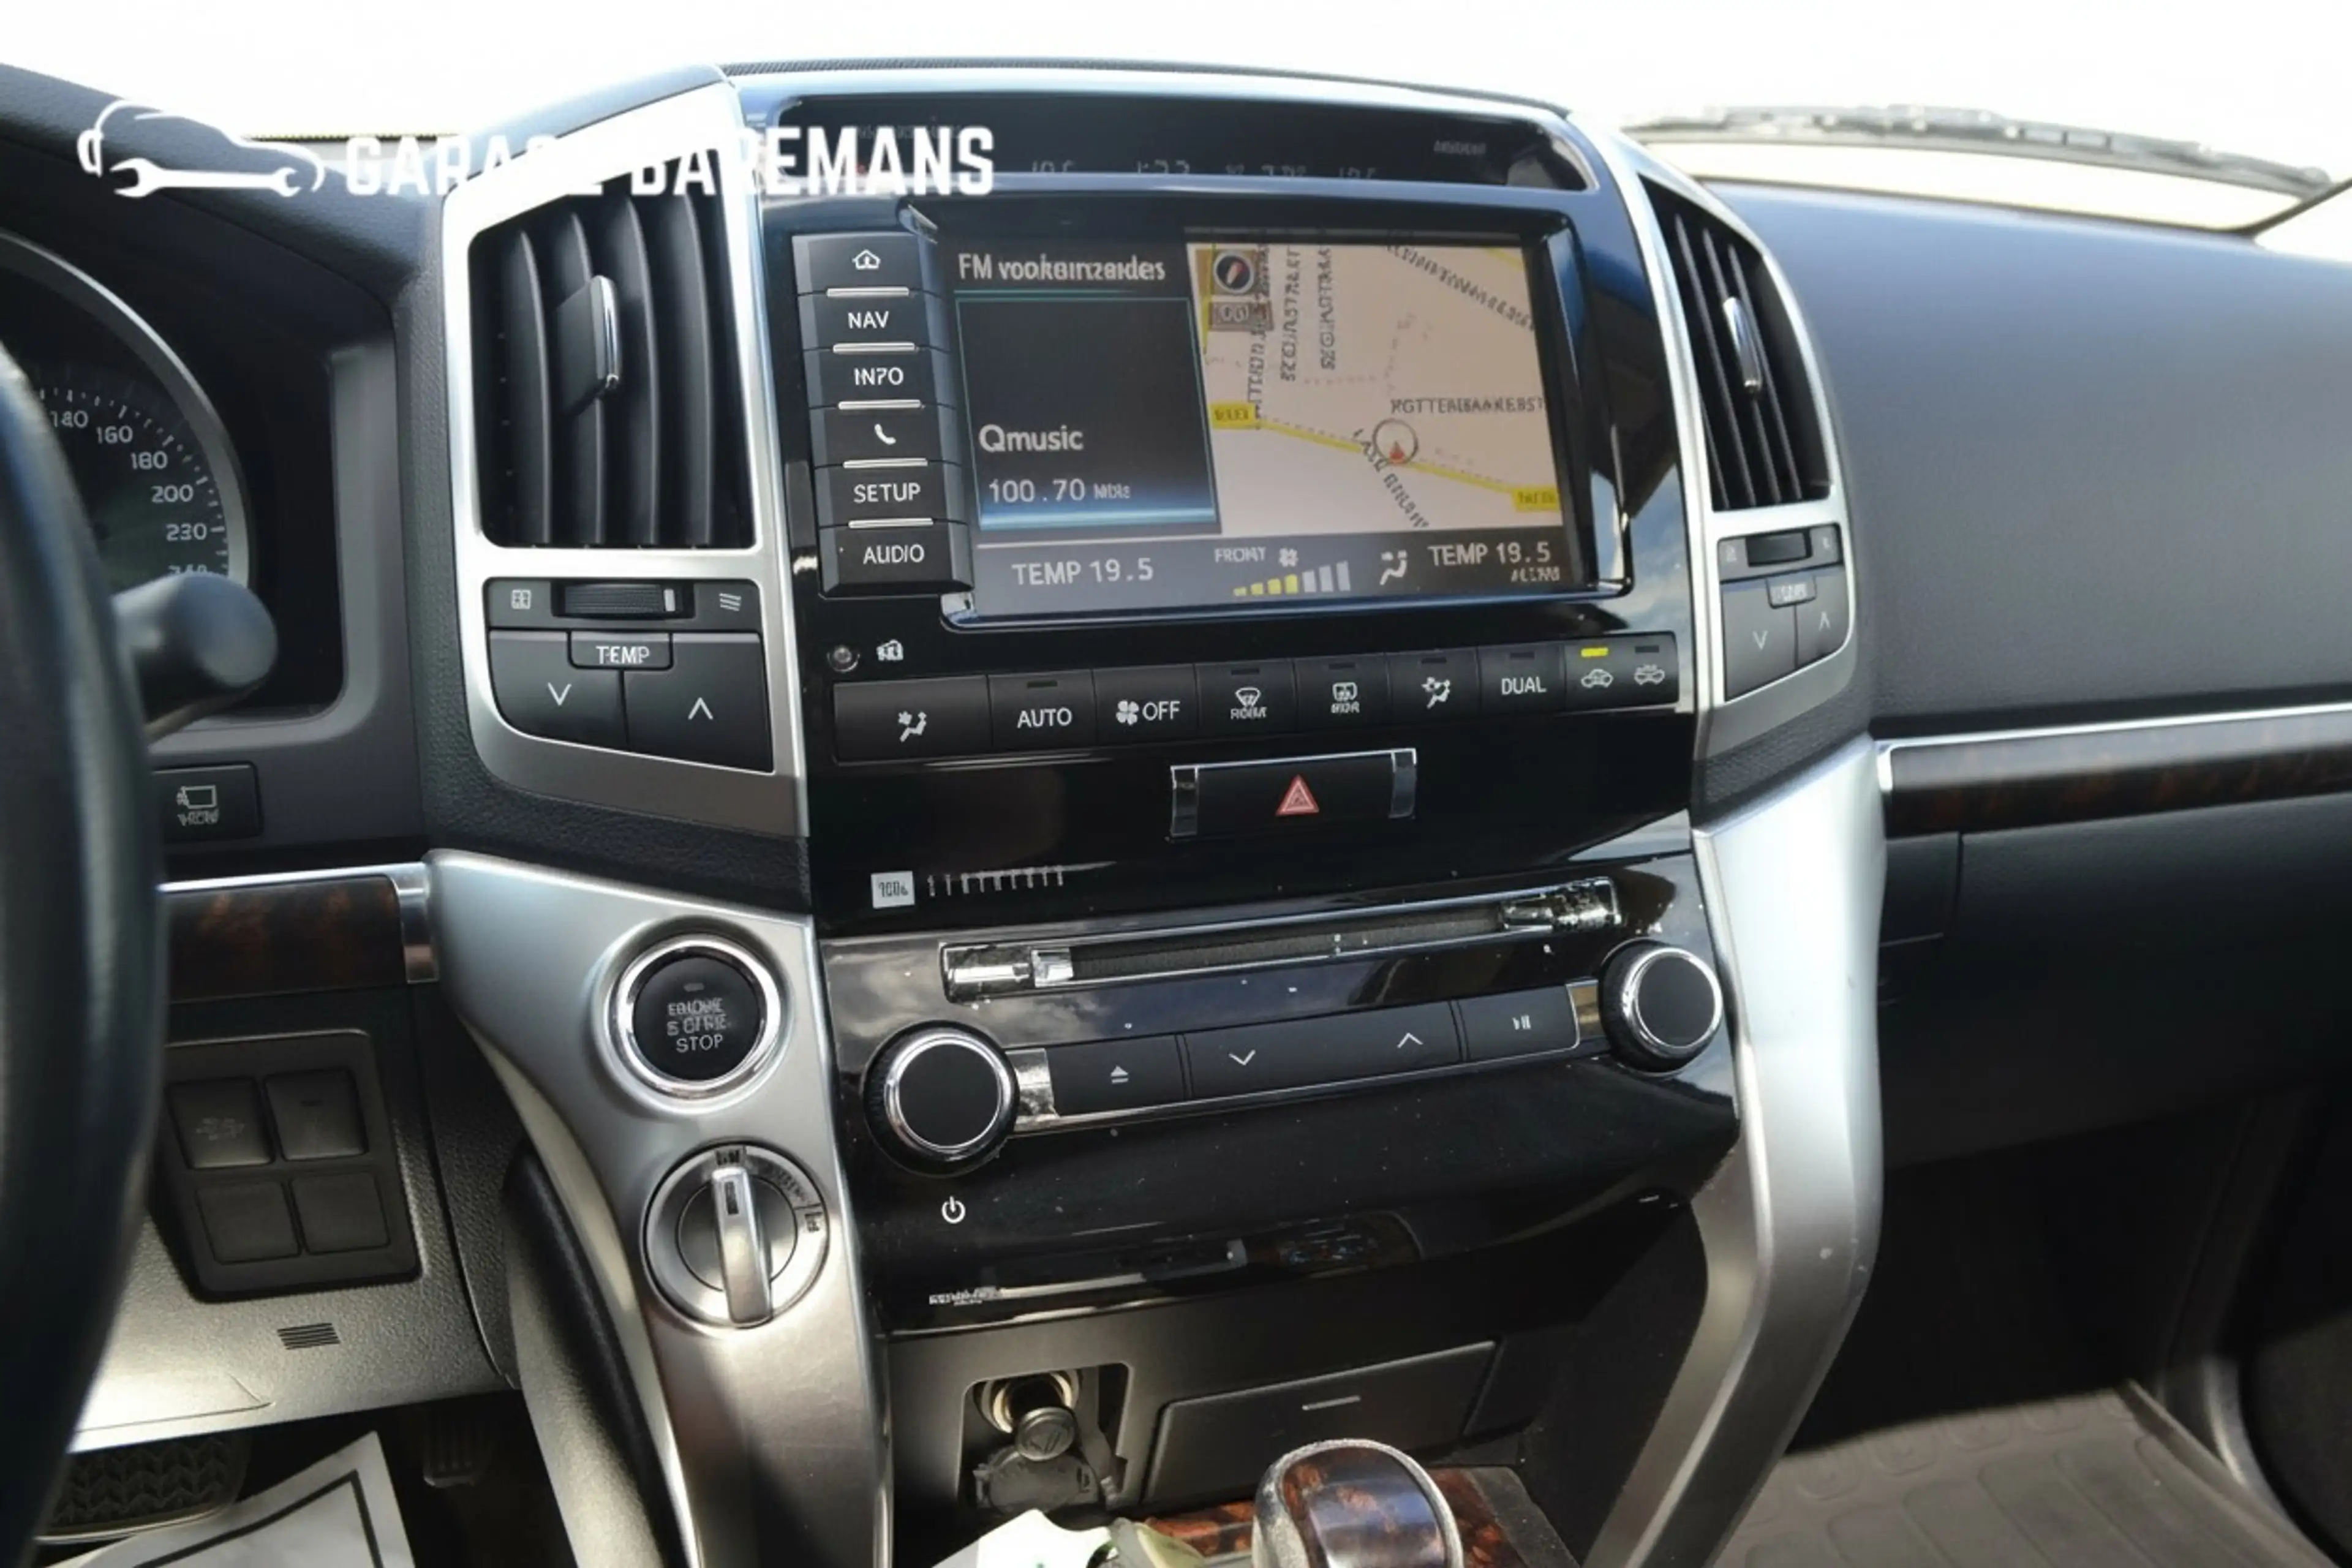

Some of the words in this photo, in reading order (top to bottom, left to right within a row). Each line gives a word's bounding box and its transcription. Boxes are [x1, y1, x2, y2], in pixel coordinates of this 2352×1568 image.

[958, 252, 992, 279] FM
[848, 311, 889, 330] NAV
[979, 423, 1084, 453] Qmusic
[130, 450, 168, 470] 180
[151, 483, 194, 504] 200
[853, 482, 921, 503] SETUP
[863, 543, 925, 565] AUDIO
[1427, 542, 1488, 567] TEMP
[1011, 560, 1082, 586] TEMP
[1088, 557, 1154, 583] 19.5
[595, 645, 650, 665] TEMP
[1501, 675, 1547, 696] DUAL
[1017, 707, 1072, 729] AUTO
[1142, 700, 1181, 721] OFF
[676, 1033, 723, 1054] STOP
